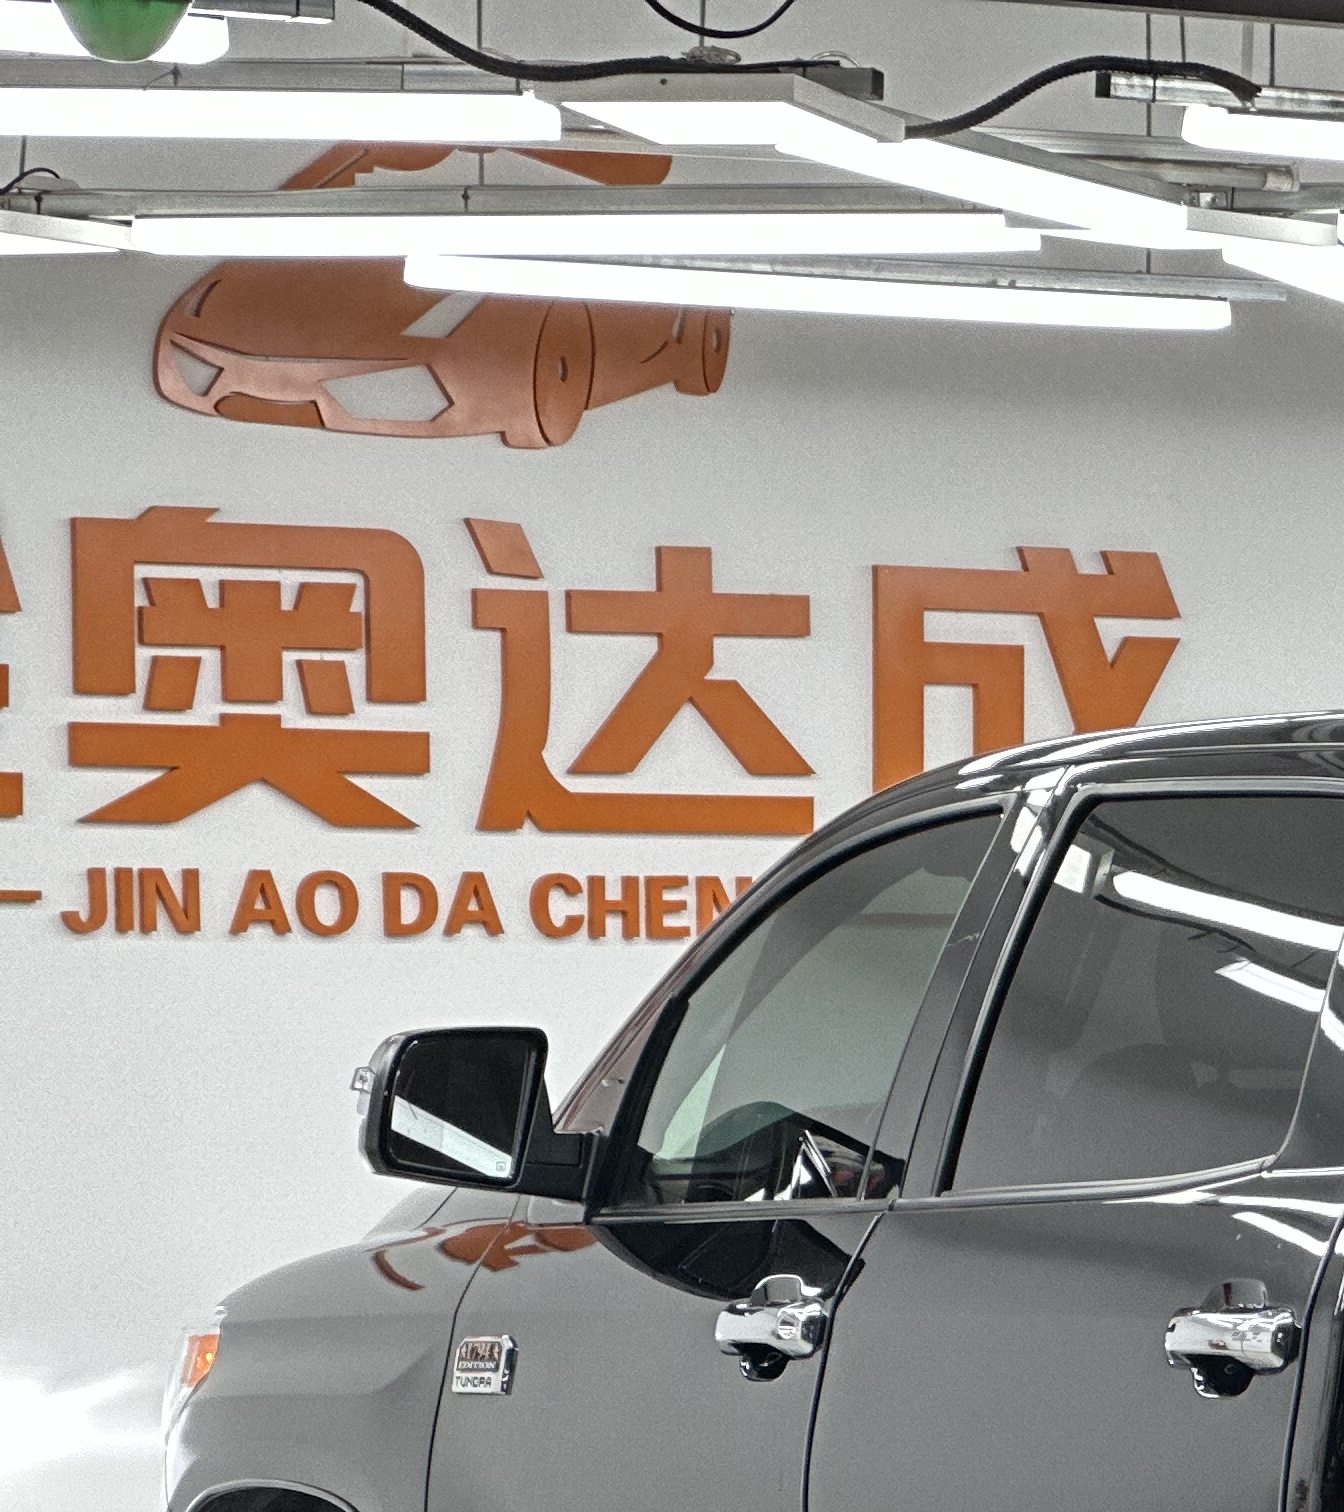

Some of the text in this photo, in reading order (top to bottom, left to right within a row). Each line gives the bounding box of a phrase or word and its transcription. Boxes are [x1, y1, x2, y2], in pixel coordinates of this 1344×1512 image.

[0, 506, 1181, 834] 奥达成
[61, 867, 201, 934] JIN
[230, 869, 359, 936] AO
[383, 872, 505, 937] DA
